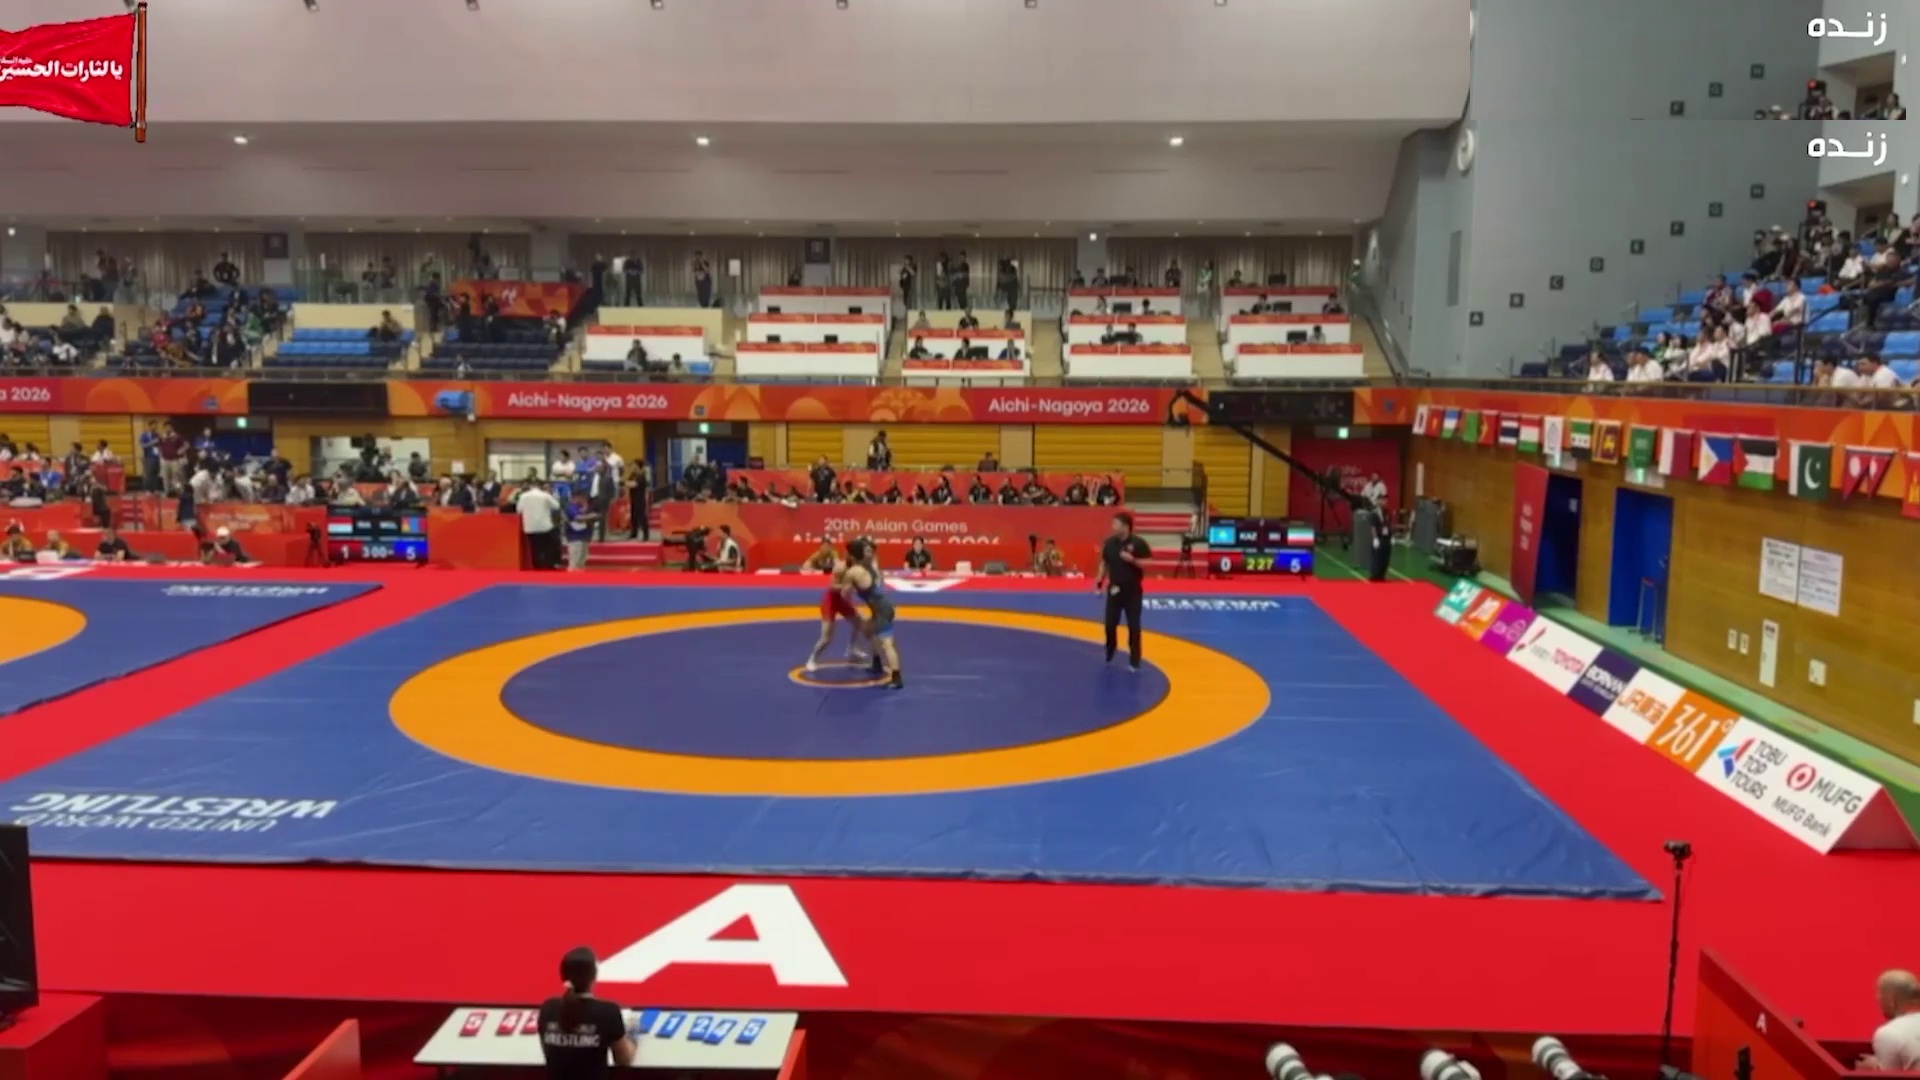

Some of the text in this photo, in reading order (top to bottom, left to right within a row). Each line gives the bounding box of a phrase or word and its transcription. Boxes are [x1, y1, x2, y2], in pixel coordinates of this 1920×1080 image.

[11, 386, 51, 401] 2026
[508, 391, 668, 412] Aichi-Nagoya 2026
[988, 397, 1150, 417] Aichi-Nagoya 2026
[823, 517, 968, 533] 20th Asian Games
[1220, 556, 1232, 572] 0
[1755, 740, 1788, 766] TOBU
[1743, 754, 1768, 776] TOP
[1730, 770, 1768, 800] TOURS
[1810, 777, 1863, 814] MUFG
[10, 793, 338, 818] WRESTLING
[1773, 795, 1833, 838] MUFG Bank
[594, 884, 849, 987] A
[691, 1017, 709, 1033] 2
[743, 1021, 761, 1037] 5
[1756, 1012, 1768, 1034] A
